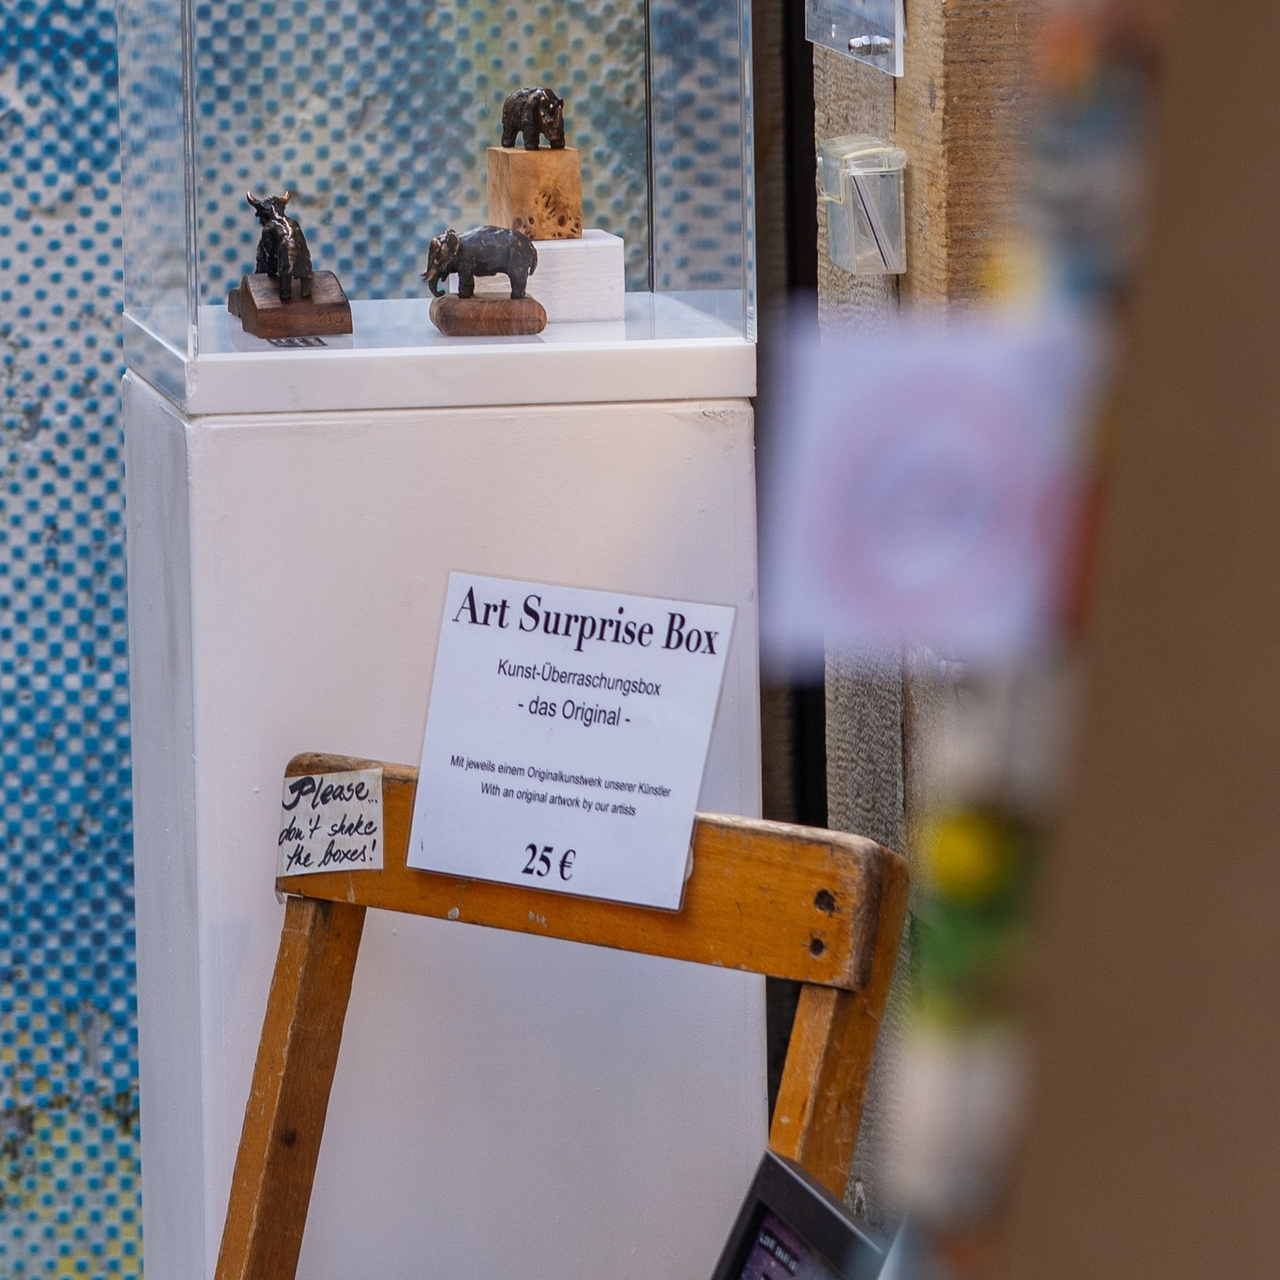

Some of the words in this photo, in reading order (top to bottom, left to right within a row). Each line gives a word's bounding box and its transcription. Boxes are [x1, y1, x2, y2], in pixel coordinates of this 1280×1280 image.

[451, 585, 511, 629] Art
[517, 593, 655, 653] Surprise
[660, 611, 720, 656] Box
[496, 657, 662, 698] Kunst-Überraschungsbox
[527, 695, 557, 718] das
[561, 698, 622, 728] Original
[450, 754, 465, 768] Mit
[465, 757, 496, 772] jeweils
[497, 763, 525, 777] einem
[527, 765, 603, 788] Originalkunstwerk
[604, 779, 637, 793] unserer
[637, 782, 672, 798] Künstler
[480, 781, 501, 797] With
[502, 787, 515, 799] an
[516, 788, 548, 804] original
[548, 795, 581, 809] artwork
[581, 797, 593, 813] by
[594, 801, 610, 814] our
[610, 803, 637, 817] artists
[278, 814, 322, 846] don't
[327, 813, 378, 838] shake
[285, 843, 315, 872] the
[318, 838, 377, 868] boxes!
[521, 842, 554, 877] 25
[558, 848, 577, 881] €
